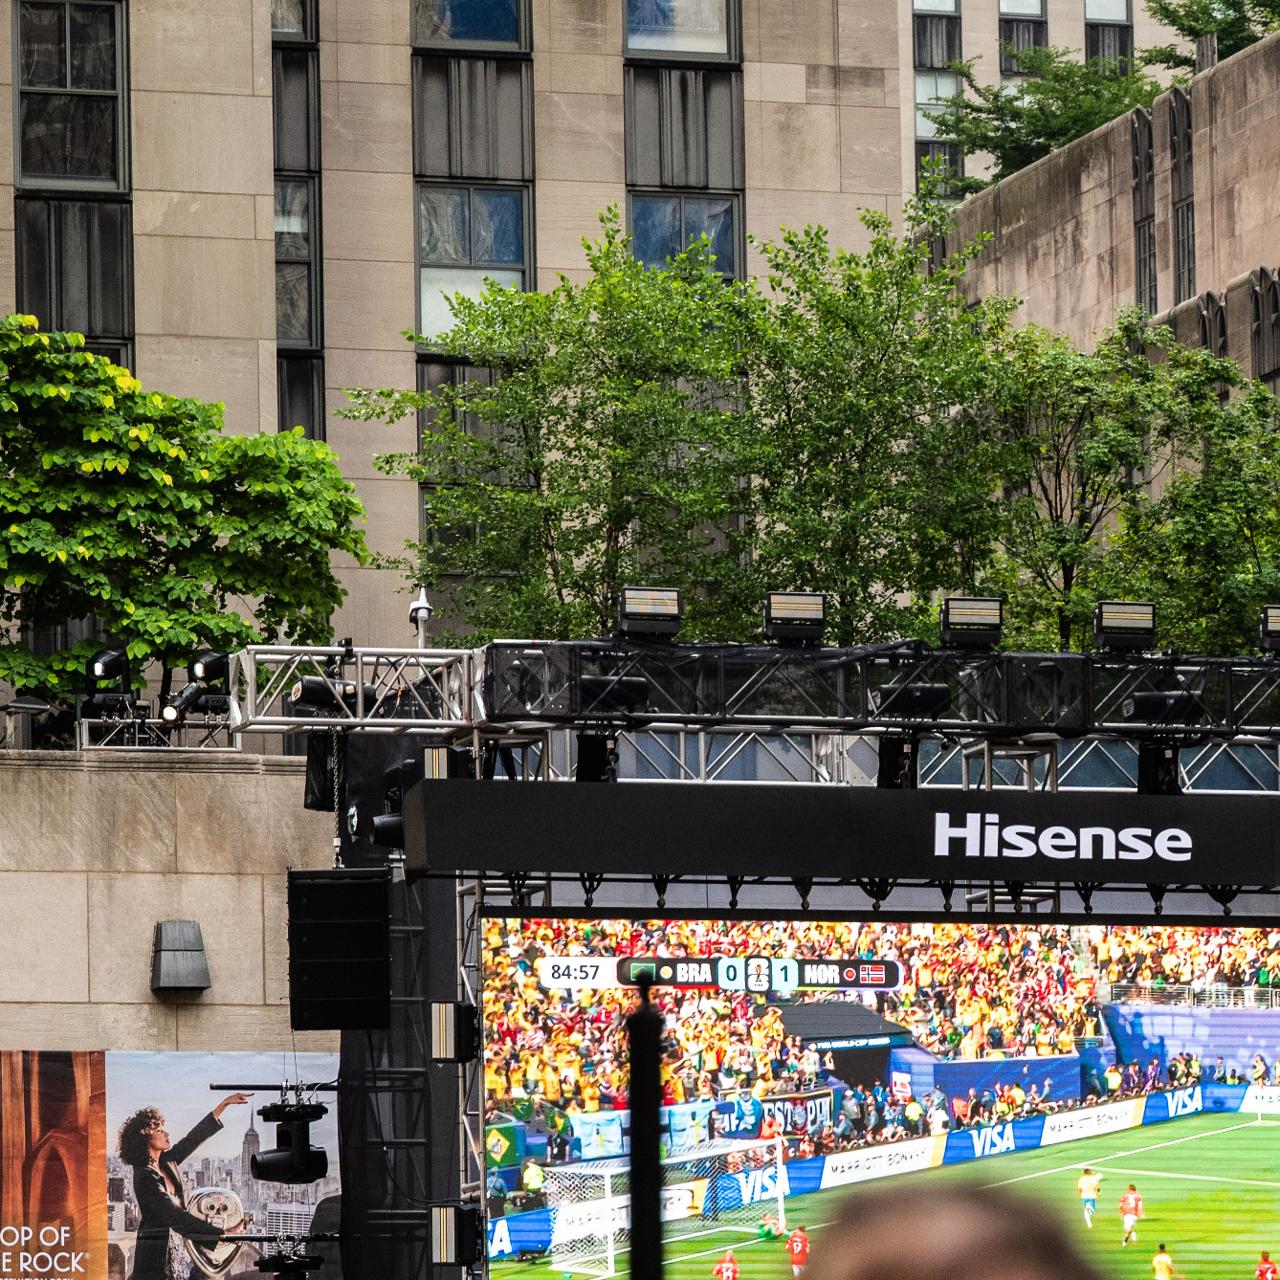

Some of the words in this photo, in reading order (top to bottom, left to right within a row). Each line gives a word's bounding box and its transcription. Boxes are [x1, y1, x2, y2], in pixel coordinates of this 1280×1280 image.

[934, 812, 1193, 862] Hisense
[551, 964, 600, 980] 84:57
[676, 962, 712, 983] BRA
[726, 964, 737, 982] 0
[780, 965, 789, 982] 1
[804, 963, 840, 985] NOR
[1164, 1085, 1203, 1118] VISA
[968, 1122, 1016, 1158] VISA
[735, 1166, 790, 1205] VISA
[39, 1226, 71, 1247] OF
